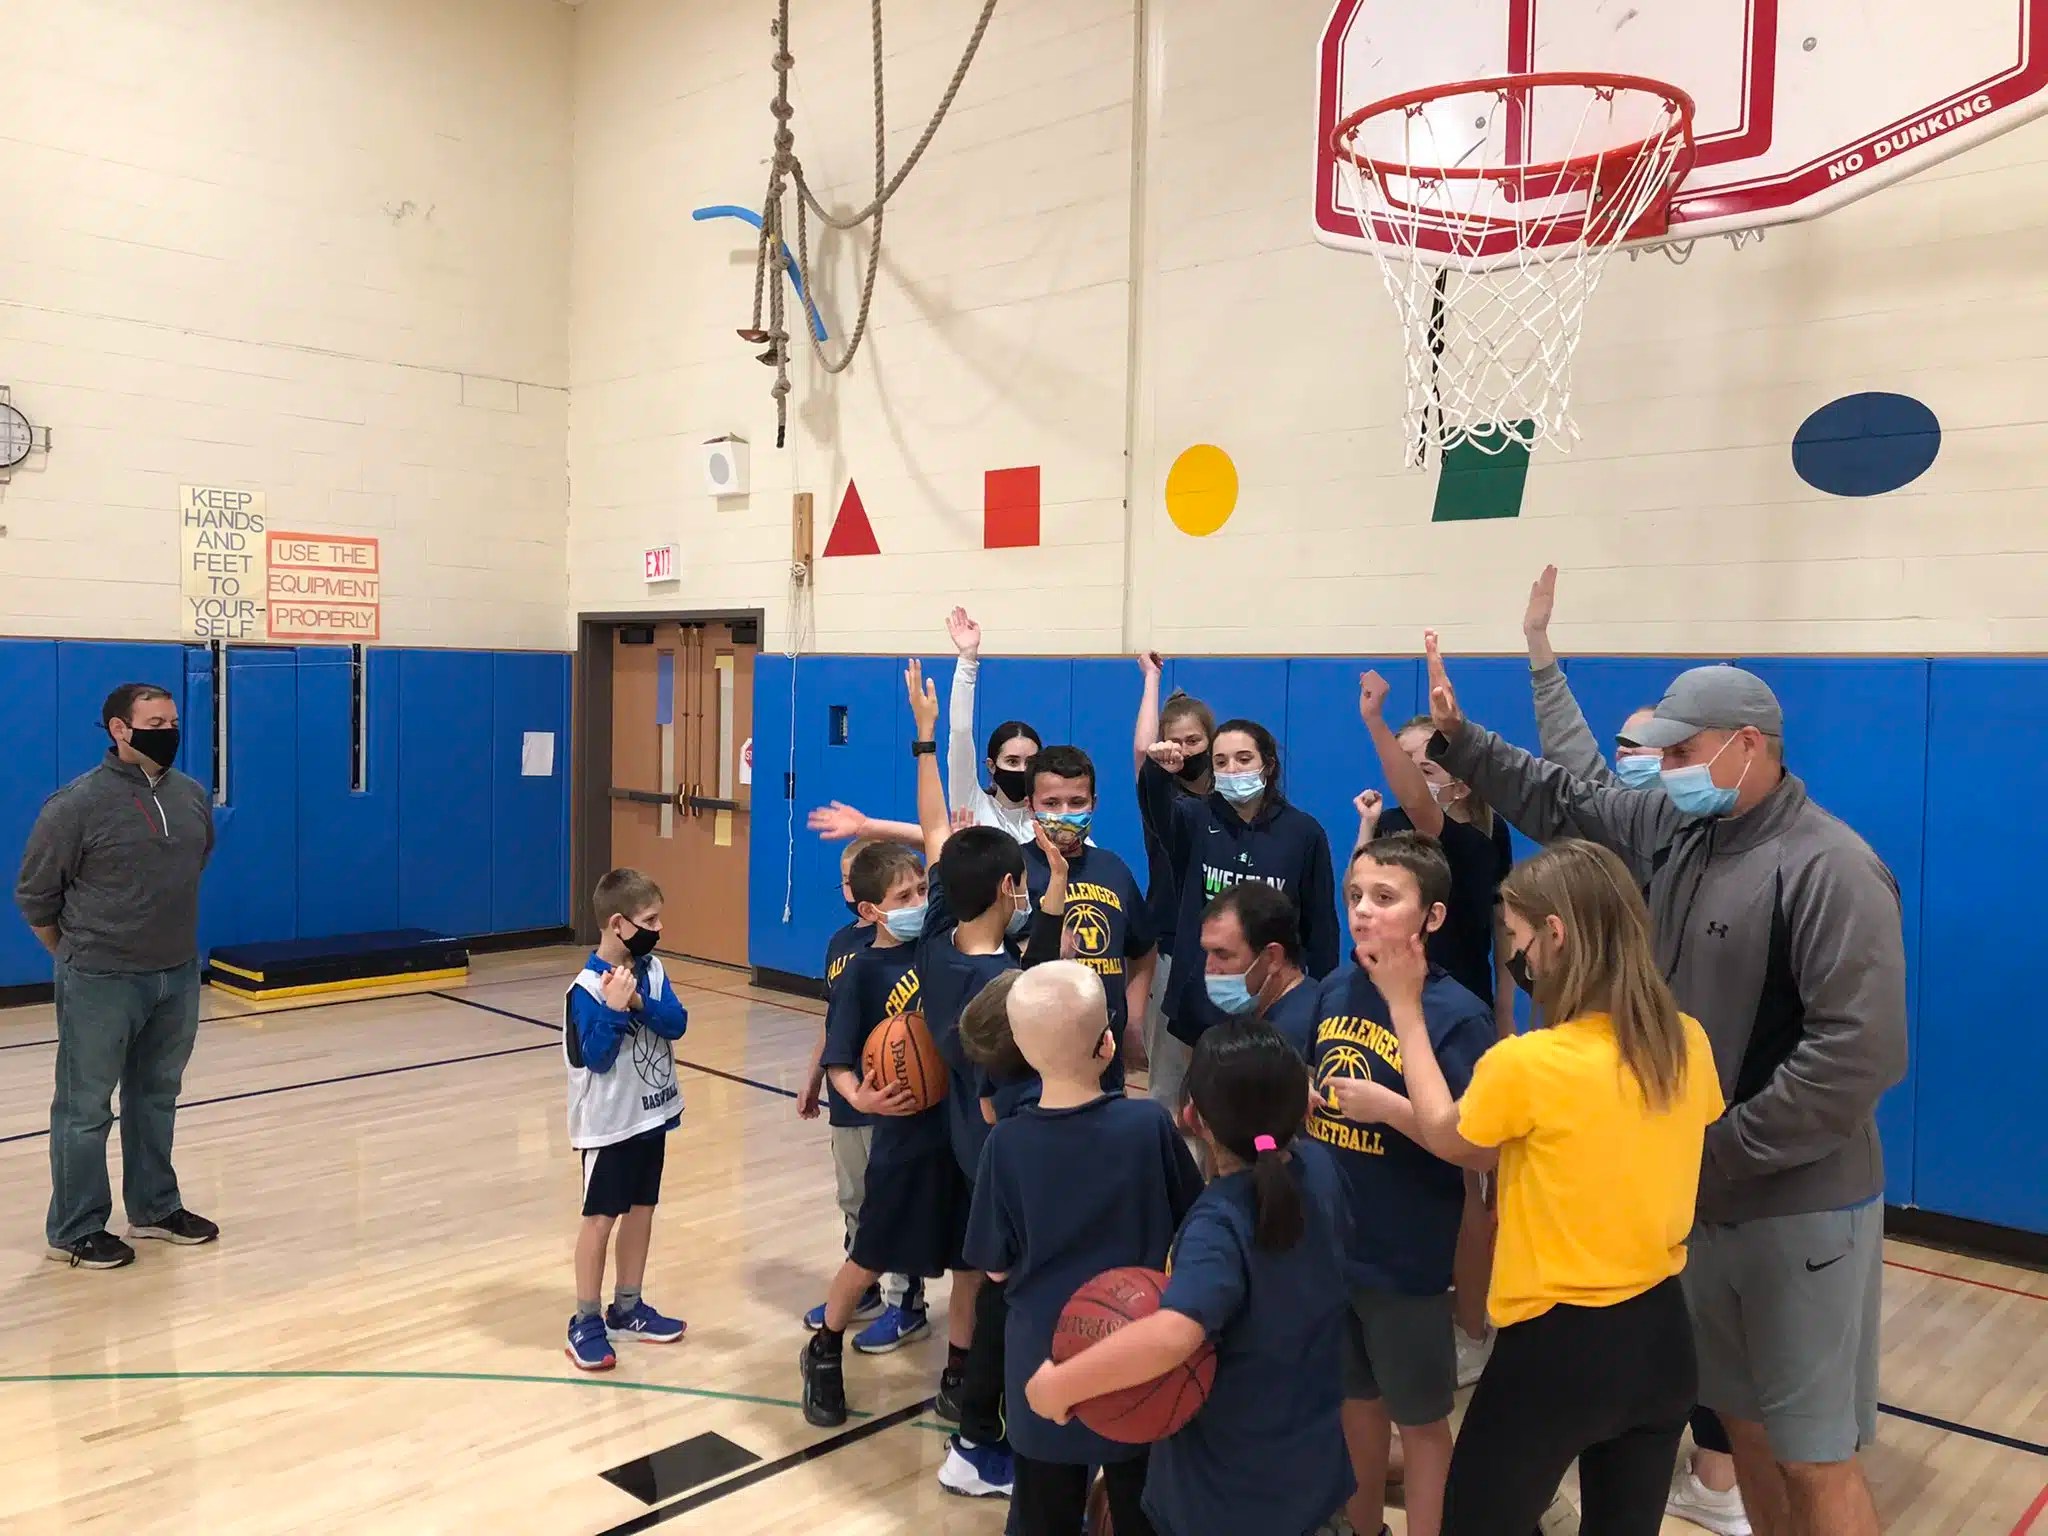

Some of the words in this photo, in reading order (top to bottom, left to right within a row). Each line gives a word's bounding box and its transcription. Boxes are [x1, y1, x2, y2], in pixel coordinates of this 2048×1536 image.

[1827, 153, 1864, 180] NO
[1873, 94, 1993, 159] DUNKING
[192, 487, 253, 511] KEEP
[184, 507, 265, 533] HANDS
[196, 530, 246, 551] AND
[193, 552, 253, 574] FEET
[278, 543, 320, 562] USE
[329, 545, 367, 564] THE
[645, 548, 671, 578] EXIT
[207, 575, 240, 596] TO
[268, 574, 379, 598] EQUIPMENT
[189, 597, 266, 620] YOUR-
[275, 607, 374, 629] PROPERLY
[194, 617, 254, 639] SELF
[885, 966, 922, 1018] CHALL
[1316, 1015, 1403, 1074] HALLENGE
[1305, 1113, 1385, 1156] SKETBALL
